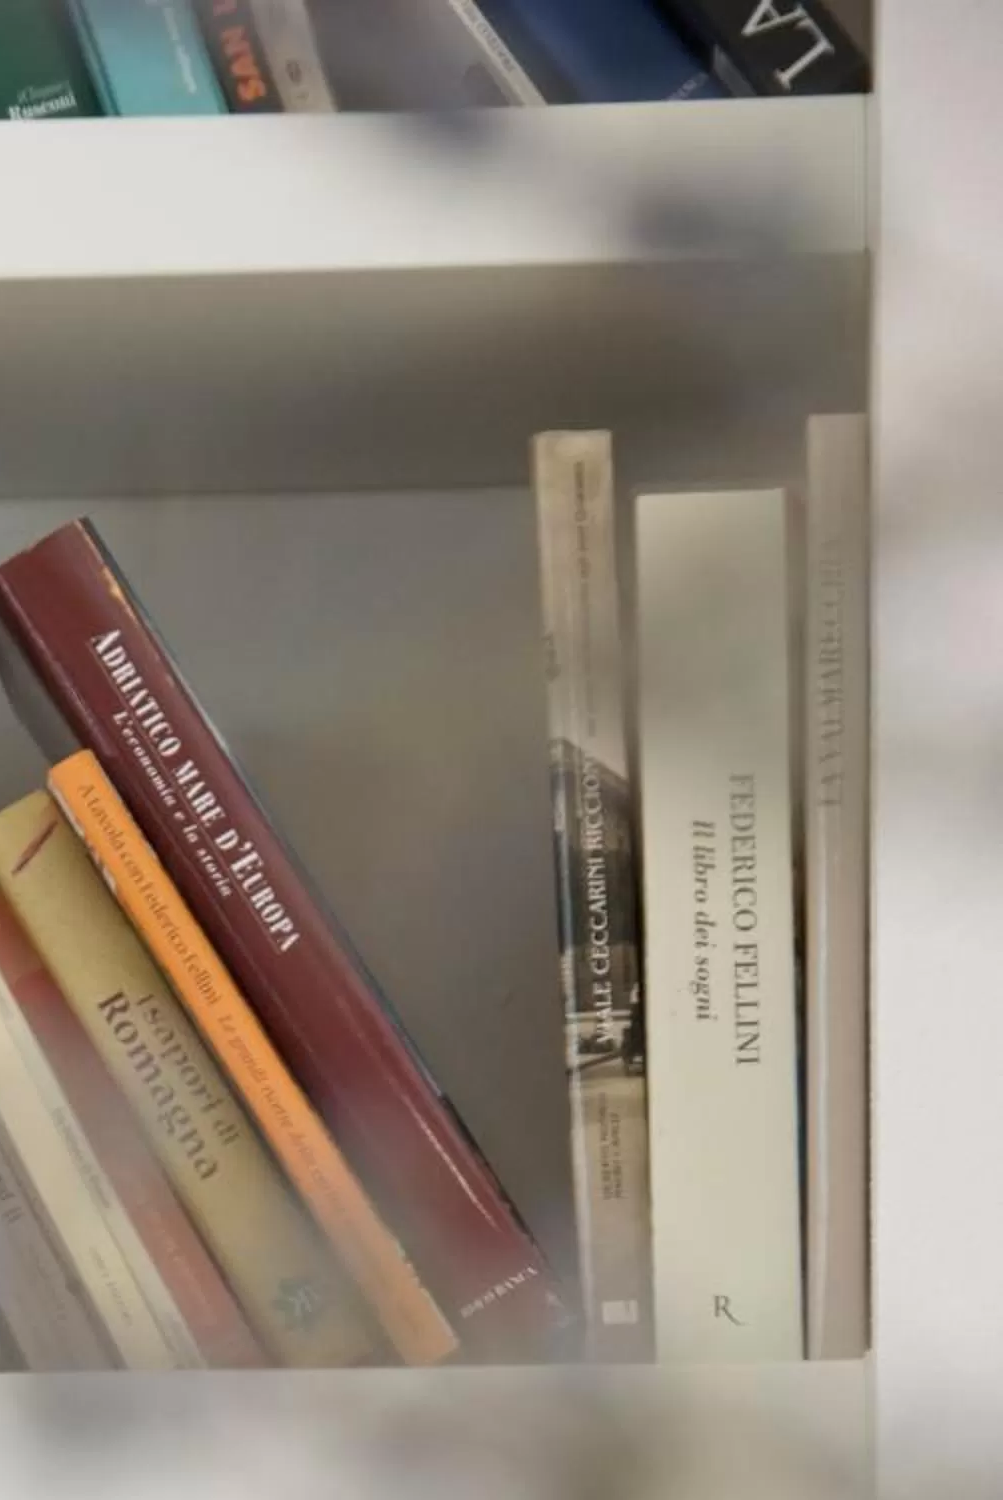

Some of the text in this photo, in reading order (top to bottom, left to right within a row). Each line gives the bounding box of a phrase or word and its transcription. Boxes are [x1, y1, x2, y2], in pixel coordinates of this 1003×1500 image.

[92, 629, 301, 953] ADRIATICO MARE D'EUROPA
[113, 710, 176, 808] L'economia
[183, 822, 199, 843] la
[197, 848, 232, 897] storia
[117, 849, 147, 886] con
[582, 752, 613, 1045] VIALE CECCARINI RICCION
[689, 820, 718, 1021] Il libro dei sogni
[729, 774, 761, 1065] FEDERICO FELLINI
[98, 991, 218, 1181] Romagna
[137, 999, 224, 1118] sapori
[212, 1113, 243, 1147] di
